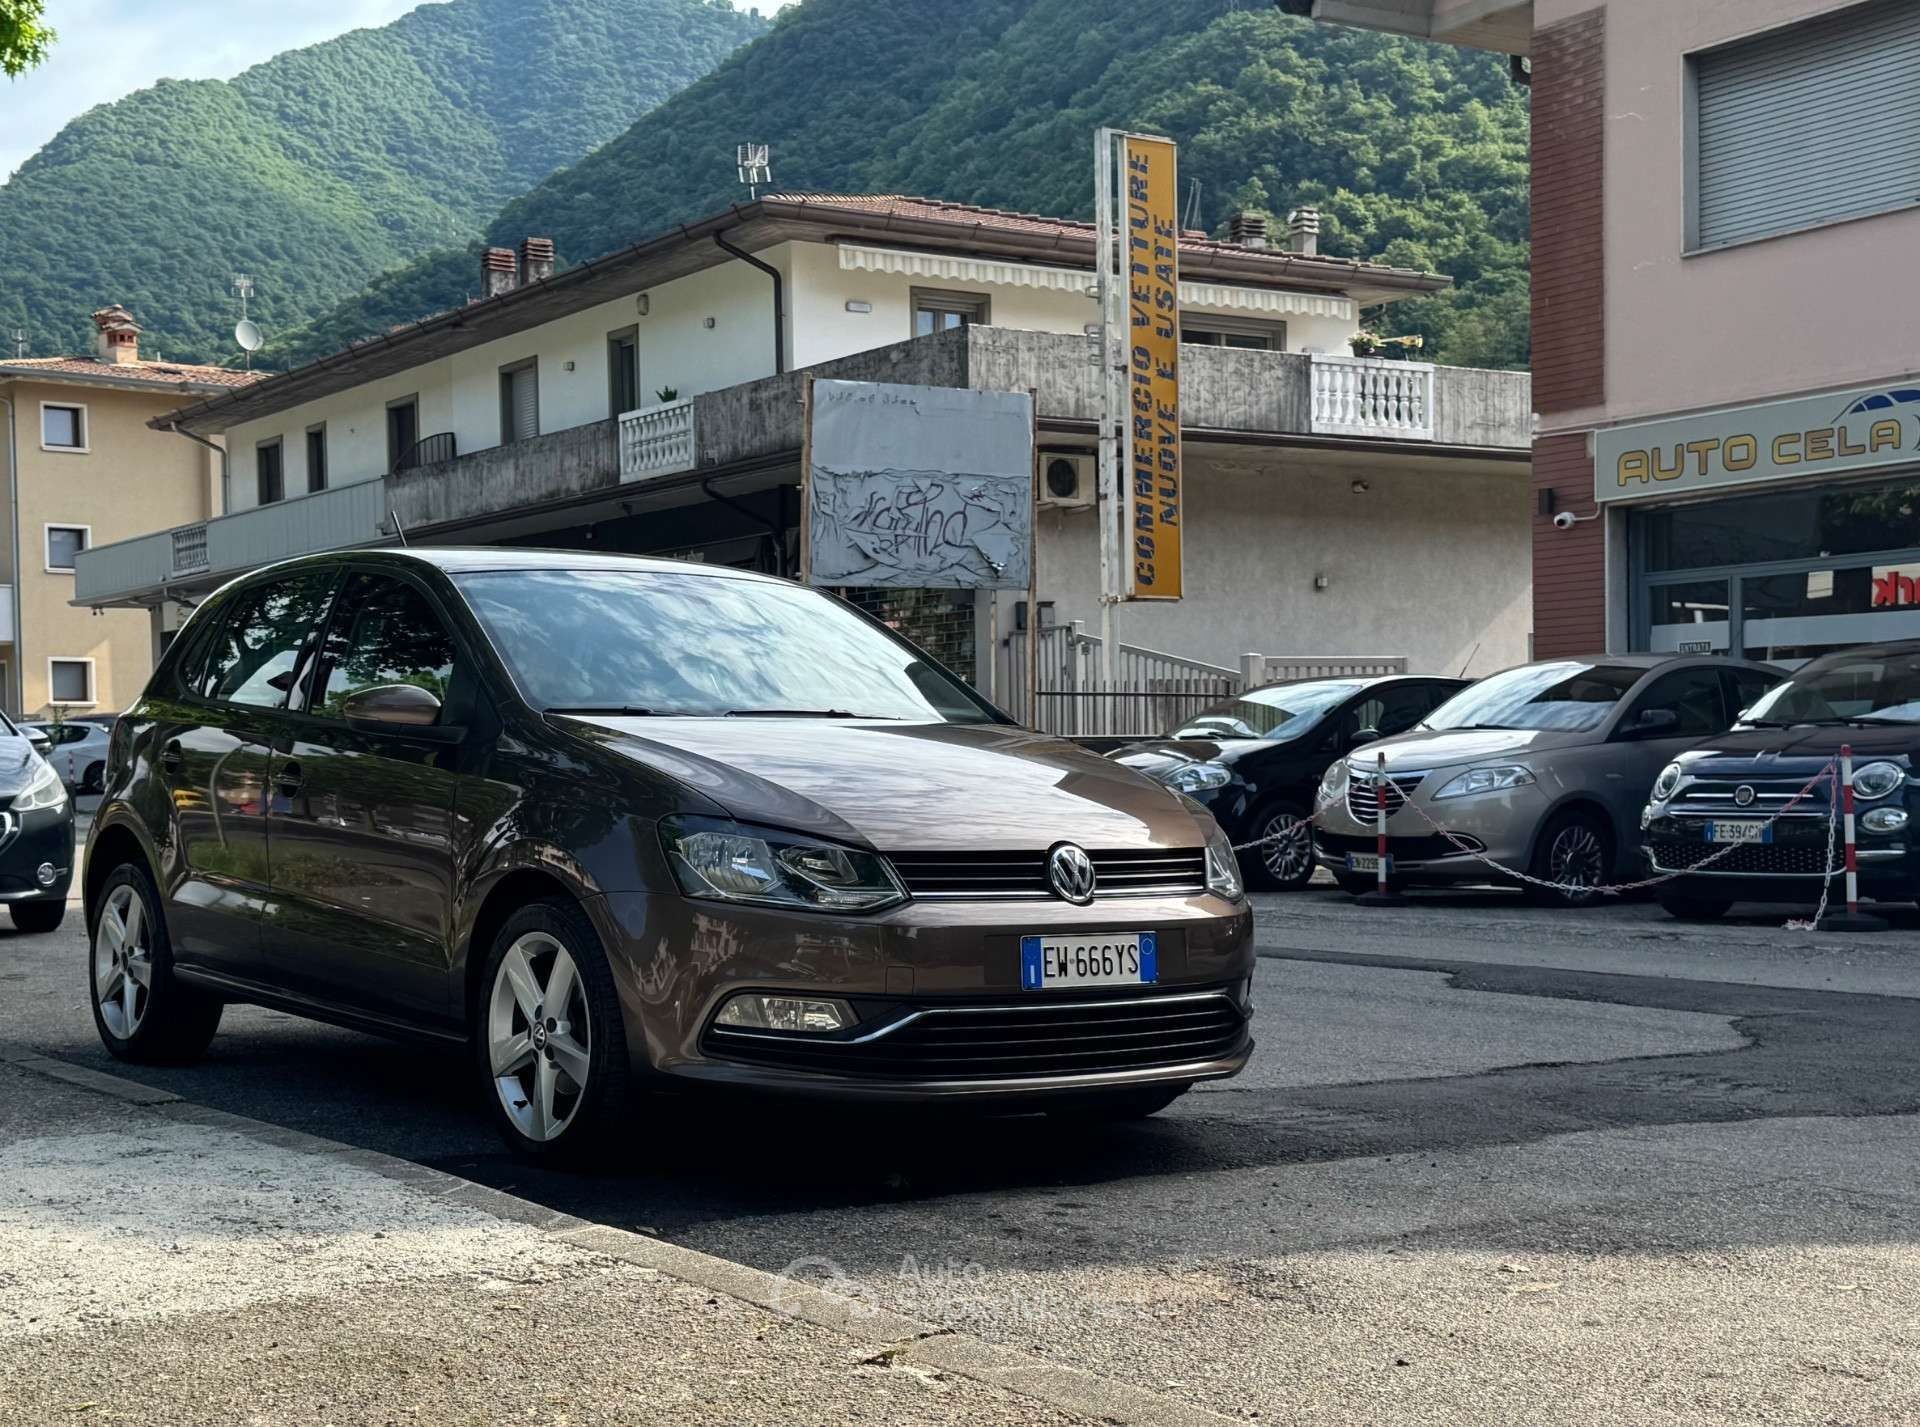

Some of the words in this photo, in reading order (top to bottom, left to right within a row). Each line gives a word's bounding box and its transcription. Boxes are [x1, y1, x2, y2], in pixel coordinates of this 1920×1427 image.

[1129, 149, 1150, 327] VETTURE
[1154, 214, 1174, 339] USATE
[1156, 357, 1175, 381] E
[1132, 346, 1154, 586] COMMERCIO
[1157, 398, 1178, 527] NUOVE
[1617, 433, 1757, 486] AUTO
[1772, 419, 1901, 465] CELA
